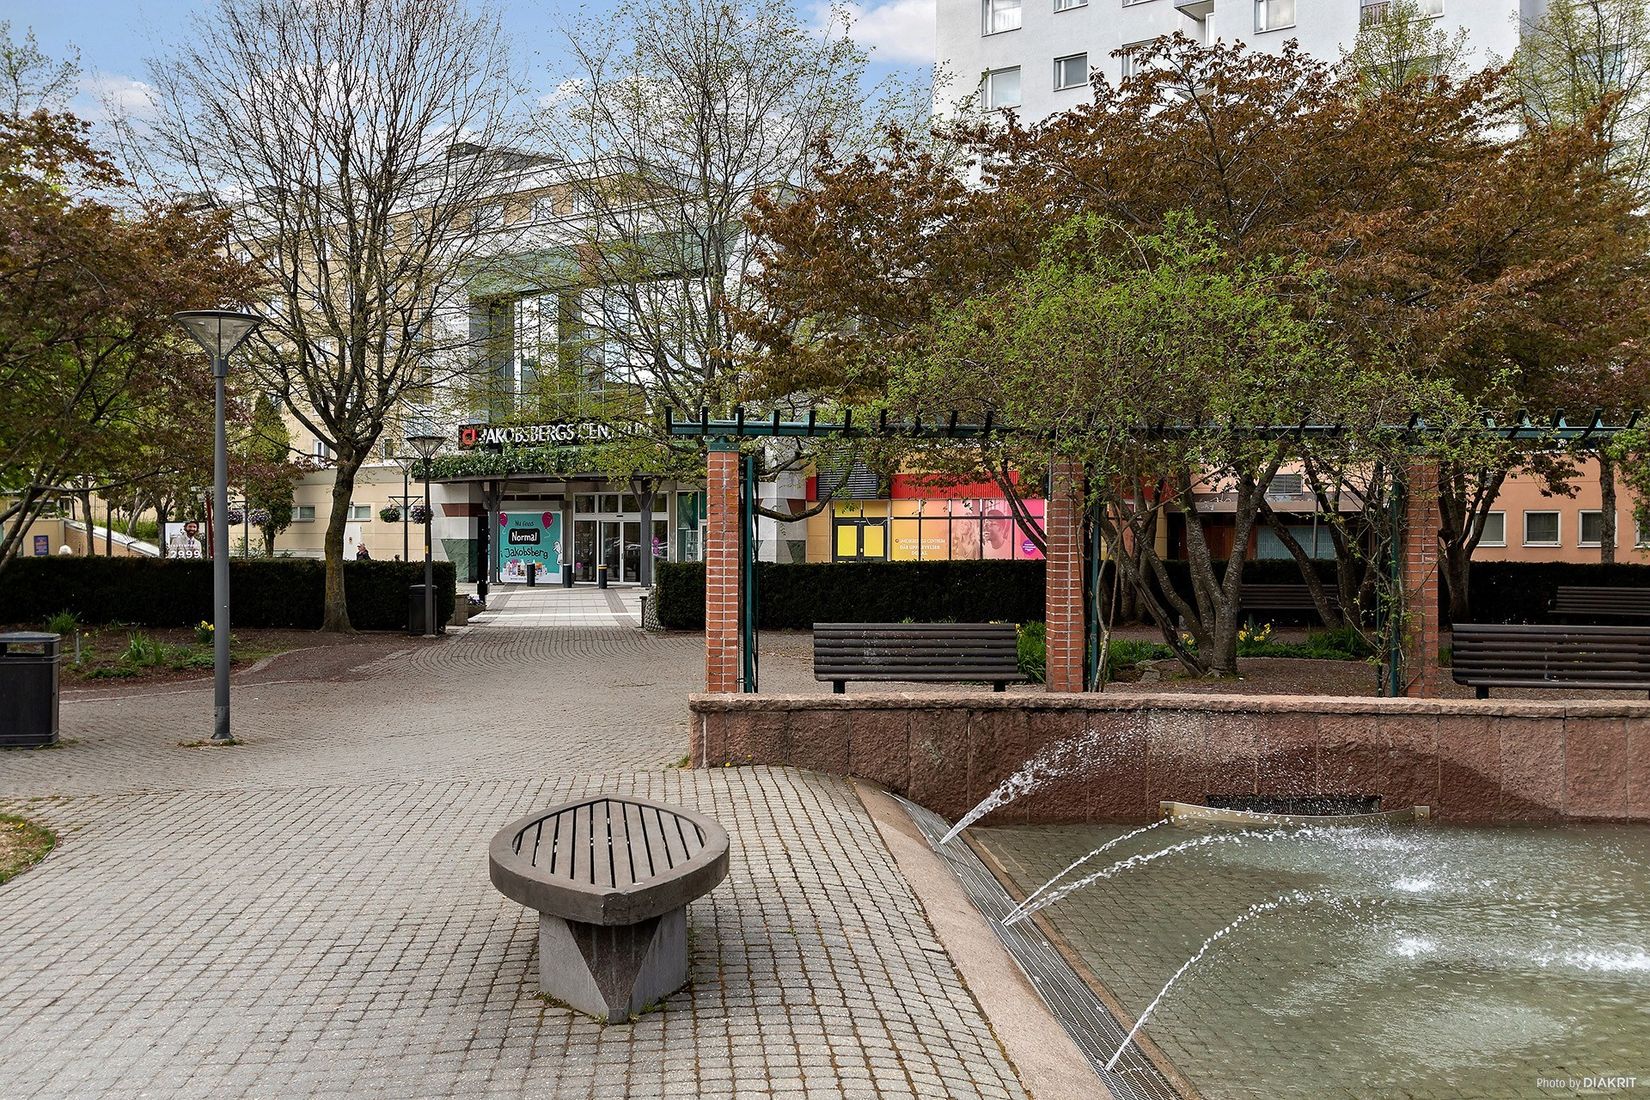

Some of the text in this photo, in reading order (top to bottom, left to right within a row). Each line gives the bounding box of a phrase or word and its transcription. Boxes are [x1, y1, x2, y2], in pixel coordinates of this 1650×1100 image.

[480, 421, 652, 443] JAKOBSBERGS CENRUM
[511, 531, 538, 541] Normal
[170, 550, 201, 559] 2999
[504, 546, 548, 559] Jakobsberg
